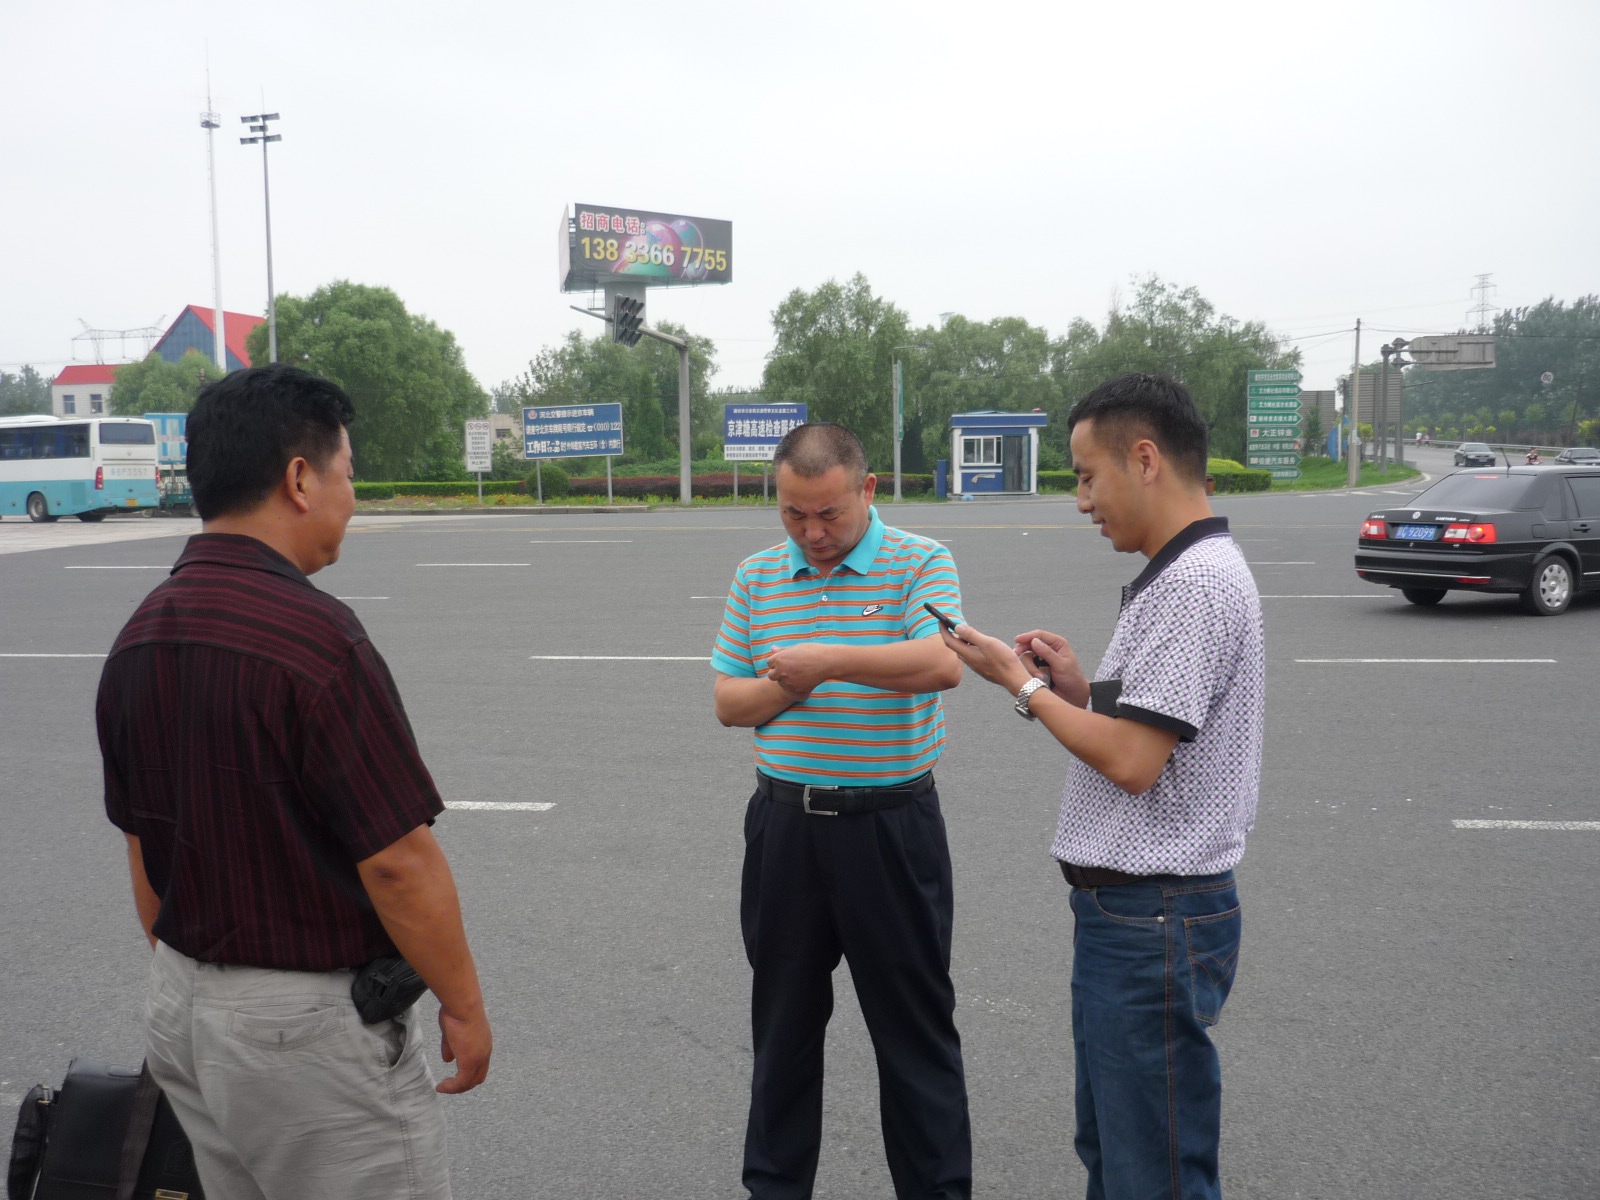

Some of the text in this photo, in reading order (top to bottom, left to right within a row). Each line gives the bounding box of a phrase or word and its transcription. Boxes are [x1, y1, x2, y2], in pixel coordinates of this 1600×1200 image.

[580, 211, 646, 235] 招商电话:
[581, 237, 727, 271] 138 3366 7755
[727, 419, 804, 437] 京津塘高速检查服务
